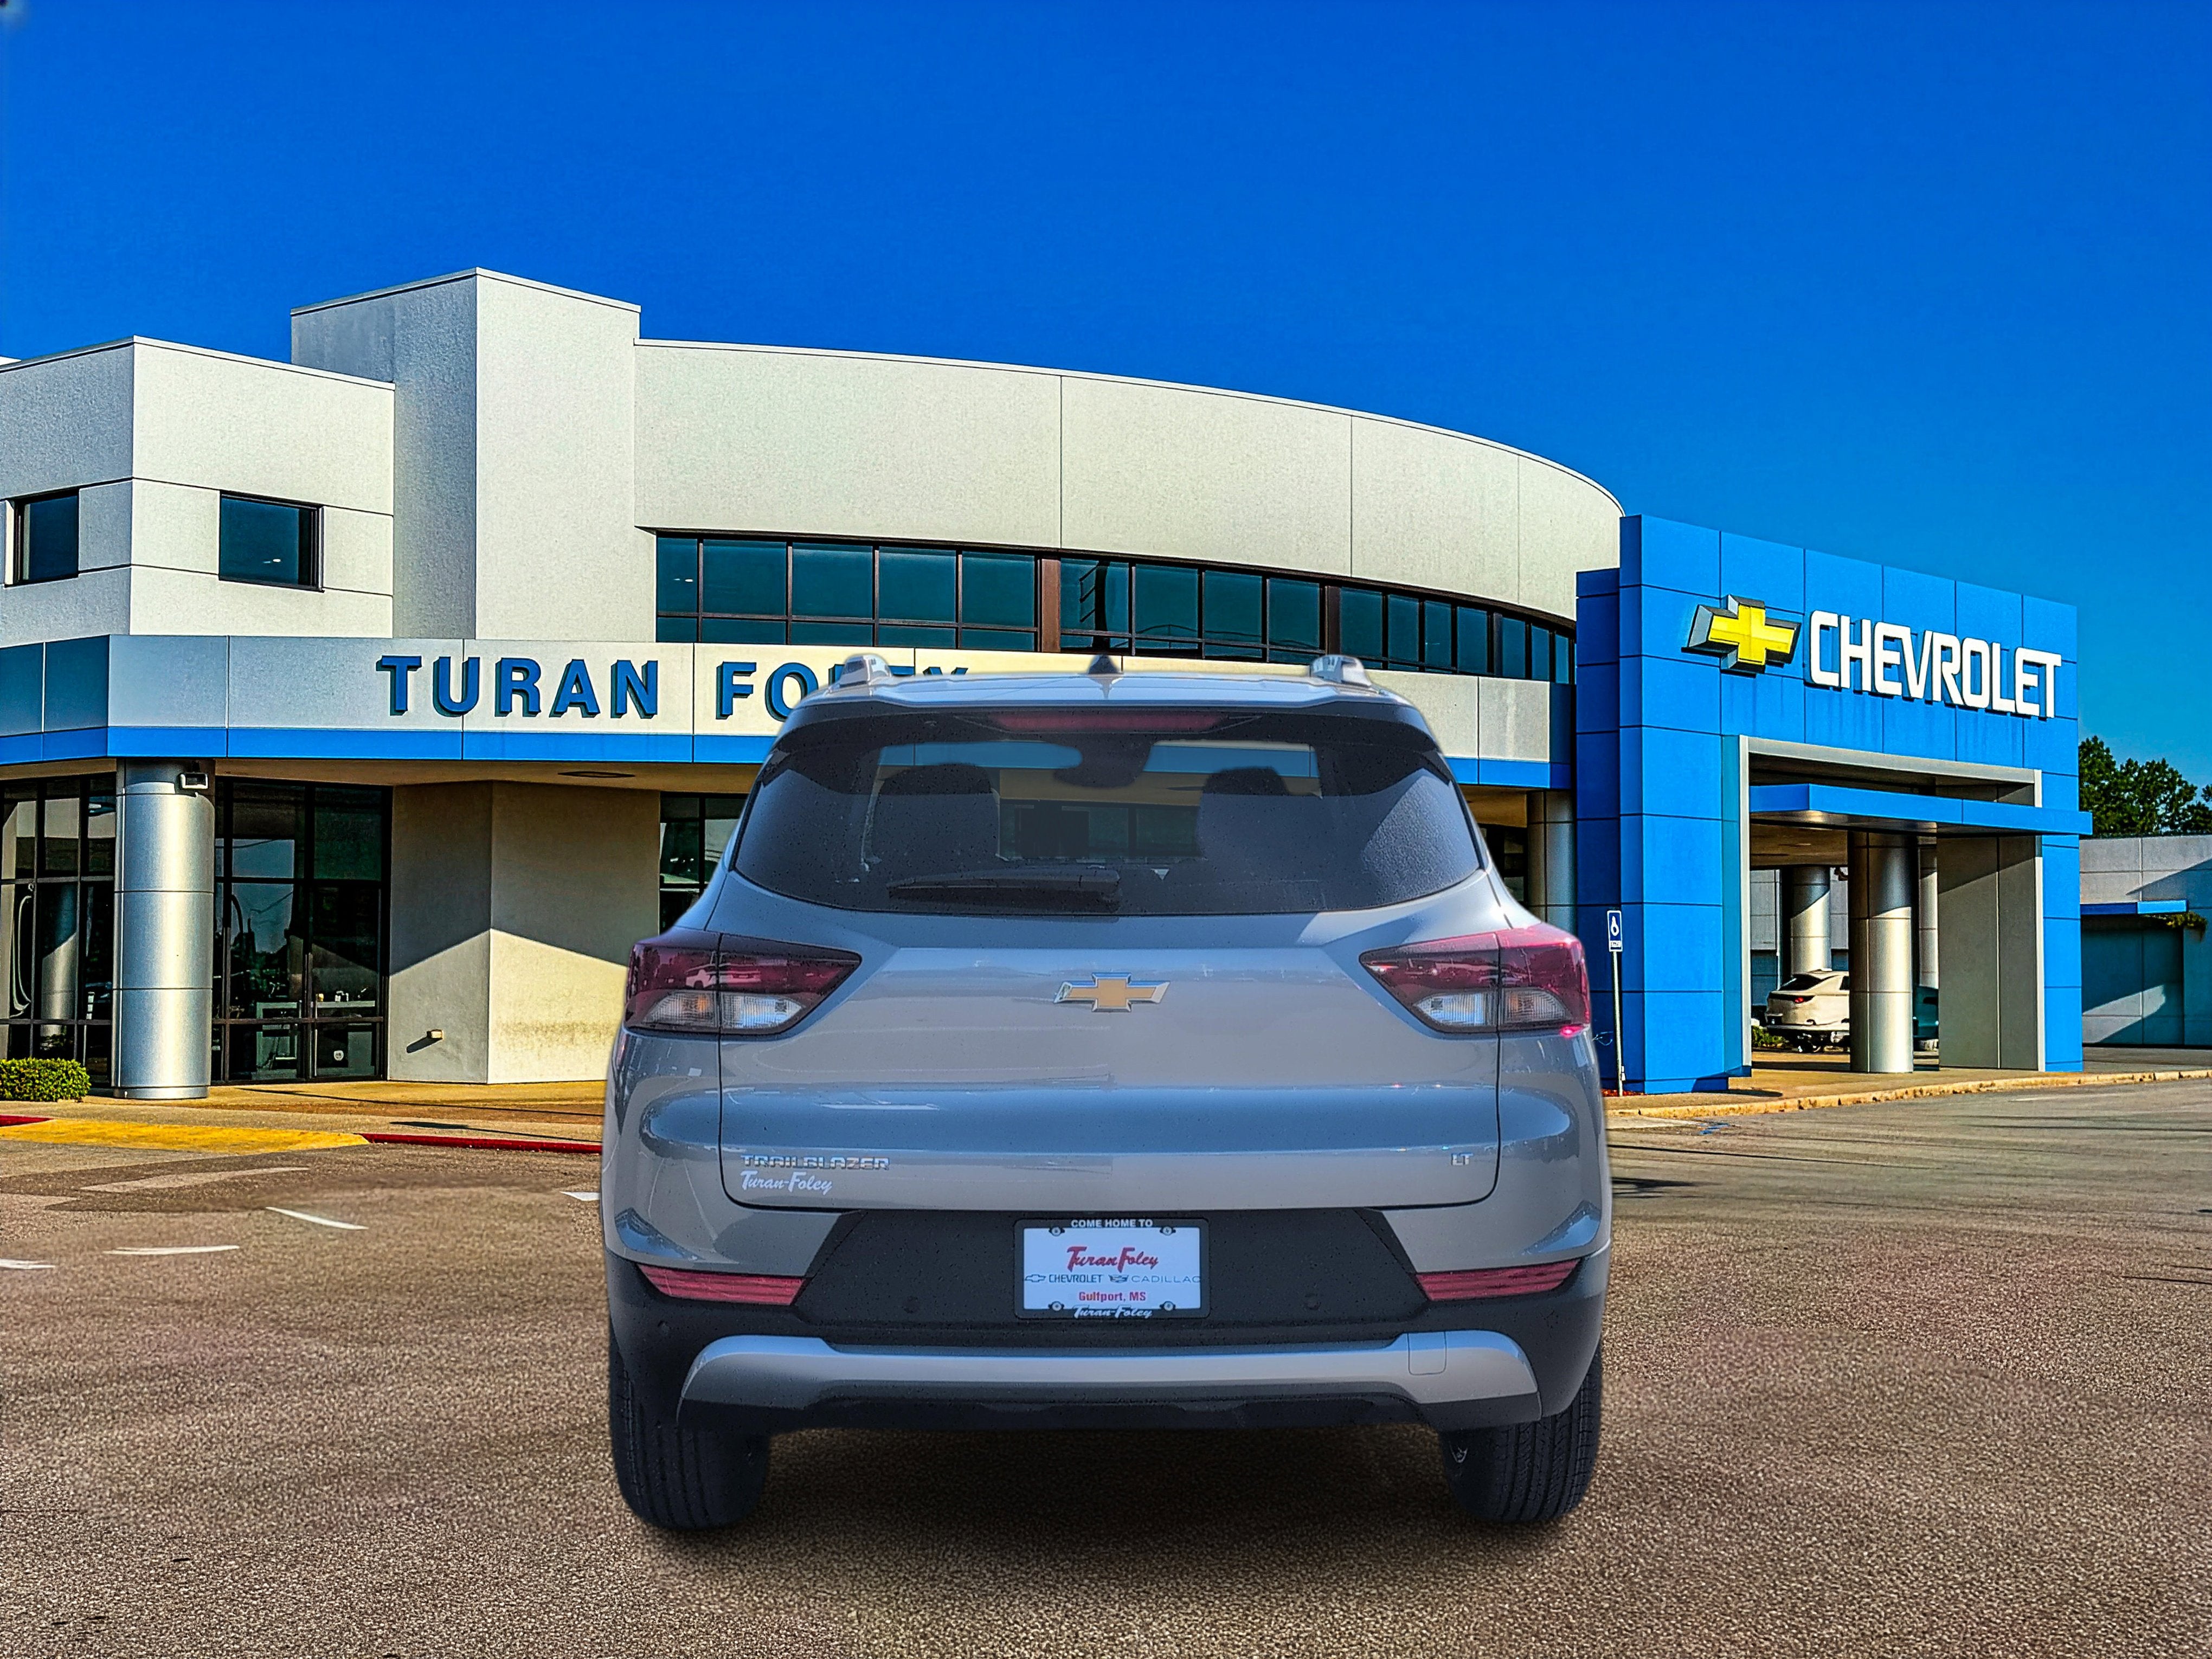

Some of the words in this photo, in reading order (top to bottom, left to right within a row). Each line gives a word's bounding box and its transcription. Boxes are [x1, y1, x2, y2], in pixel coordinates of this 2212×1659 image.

[1810, 610, 2061, 718] CHEVROLET
[376, 655, 658, 719] TURAN
[741, 1154, 890, 1170] TRAILBLAZER
[1451, 1153, 1474, 1166] LT
[741, 1170, 833, 1196] Turan-Foley
[1071, 1219, 1102, 1227] COME
[1104, 1219, 1136, 1227] HOME
[1139, 1218, 1153, 1227] TO
[1049, 1274, 1104, 1283] CHEVROLET
[1131, 1275, 1200, 1283] CADILLAC
[1079, 1291, 1126, 1302] Gulfport,
[1129, 1291, 1146, 1301] MS
